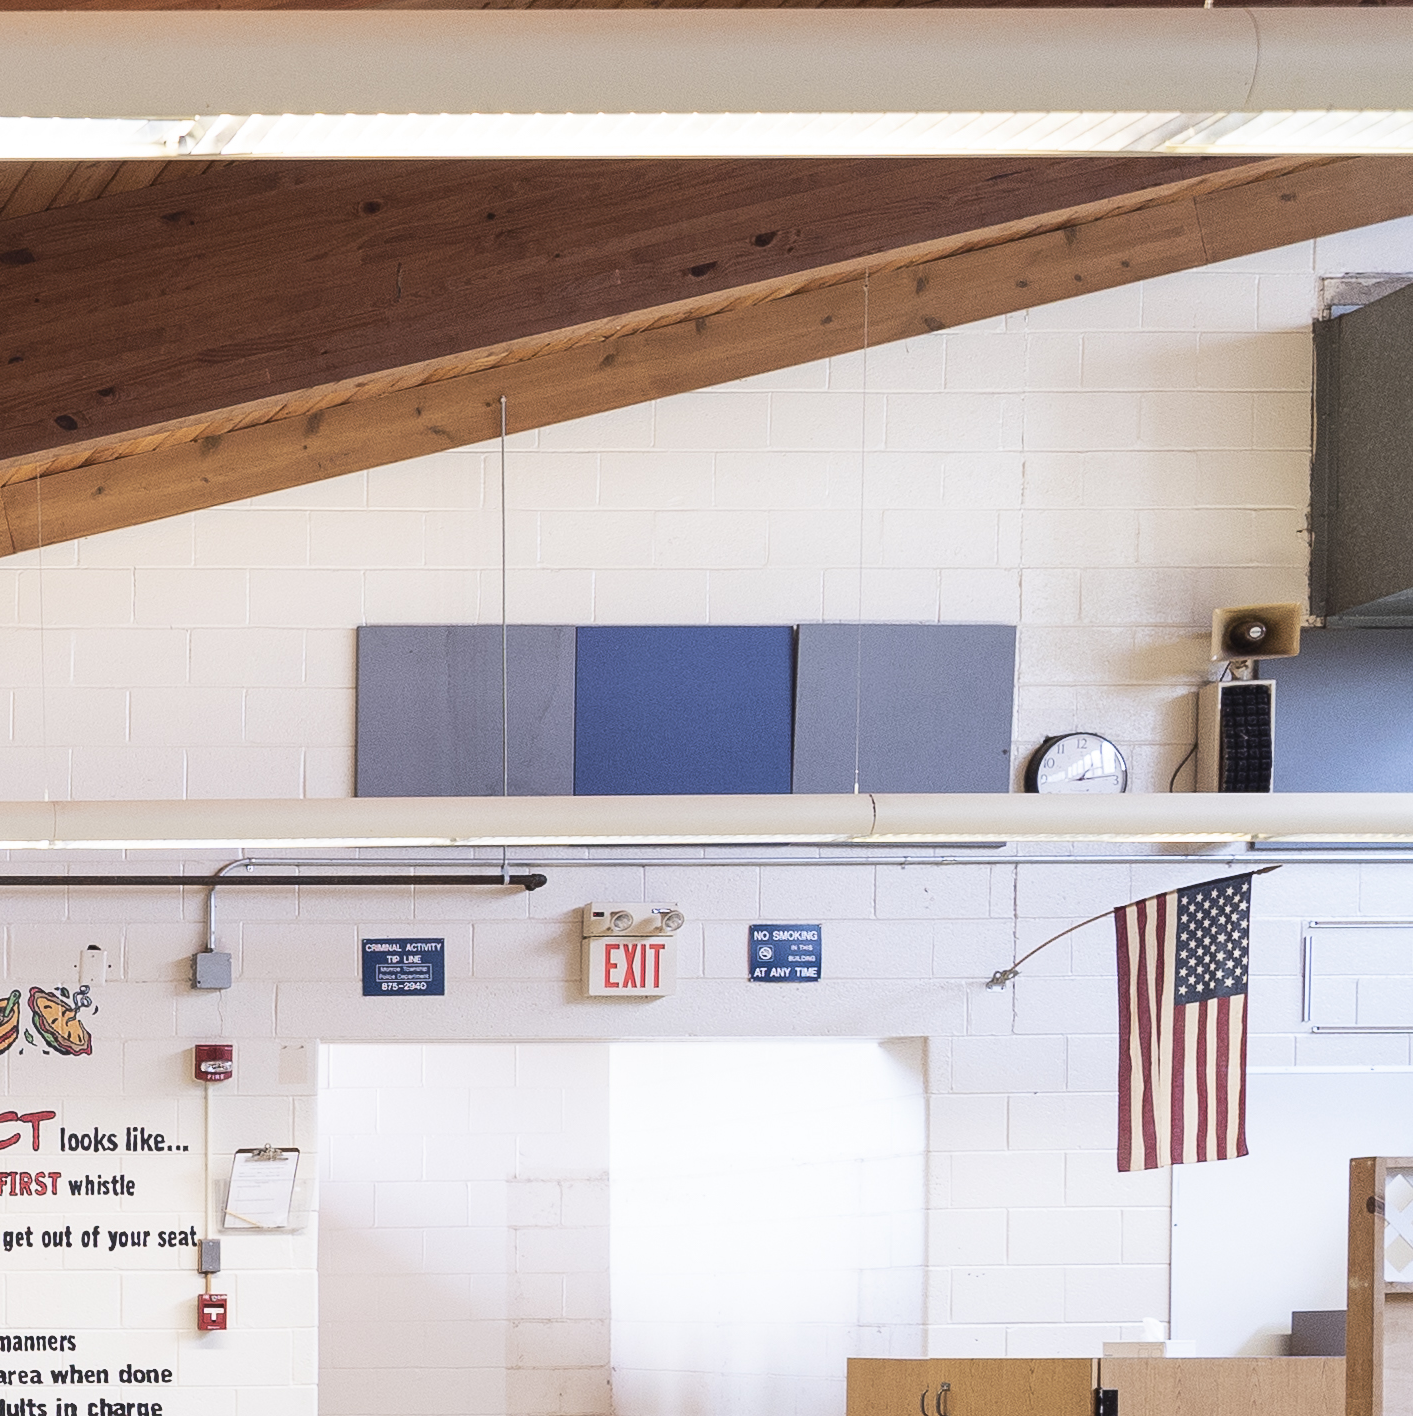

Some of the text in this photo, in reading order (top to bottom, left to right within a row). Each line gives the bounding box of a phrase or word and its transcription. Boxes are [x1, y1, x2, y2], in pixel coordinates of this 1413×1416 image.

[753, 930, 818, 941] NO SMOKING
[365, 942, 442, 952] CRIMINAL ACTIVITY
[386, 954, 422, 963] TIP LINE
[604, 943, 666, 989] EXIT
[753, 967, 818, 977] AT ANY TIME
[381, 982, 427, 991] 875-2940
[61, 1126, 119, 1153] looks
[126, 1126, 189, 1152] like...
[69, 1174, 136, 1197] whistle
[3, 1226, 34, 1252] get
[42, 1225, 73, 1248] out
[81, 1225, 100, 1248] of
[108, 1230, 151, 1252] your
[158, 1225, 198, 1248] seat
[51, 1364, 109, 1385] when
[118, 1363, 173, 1384] done
